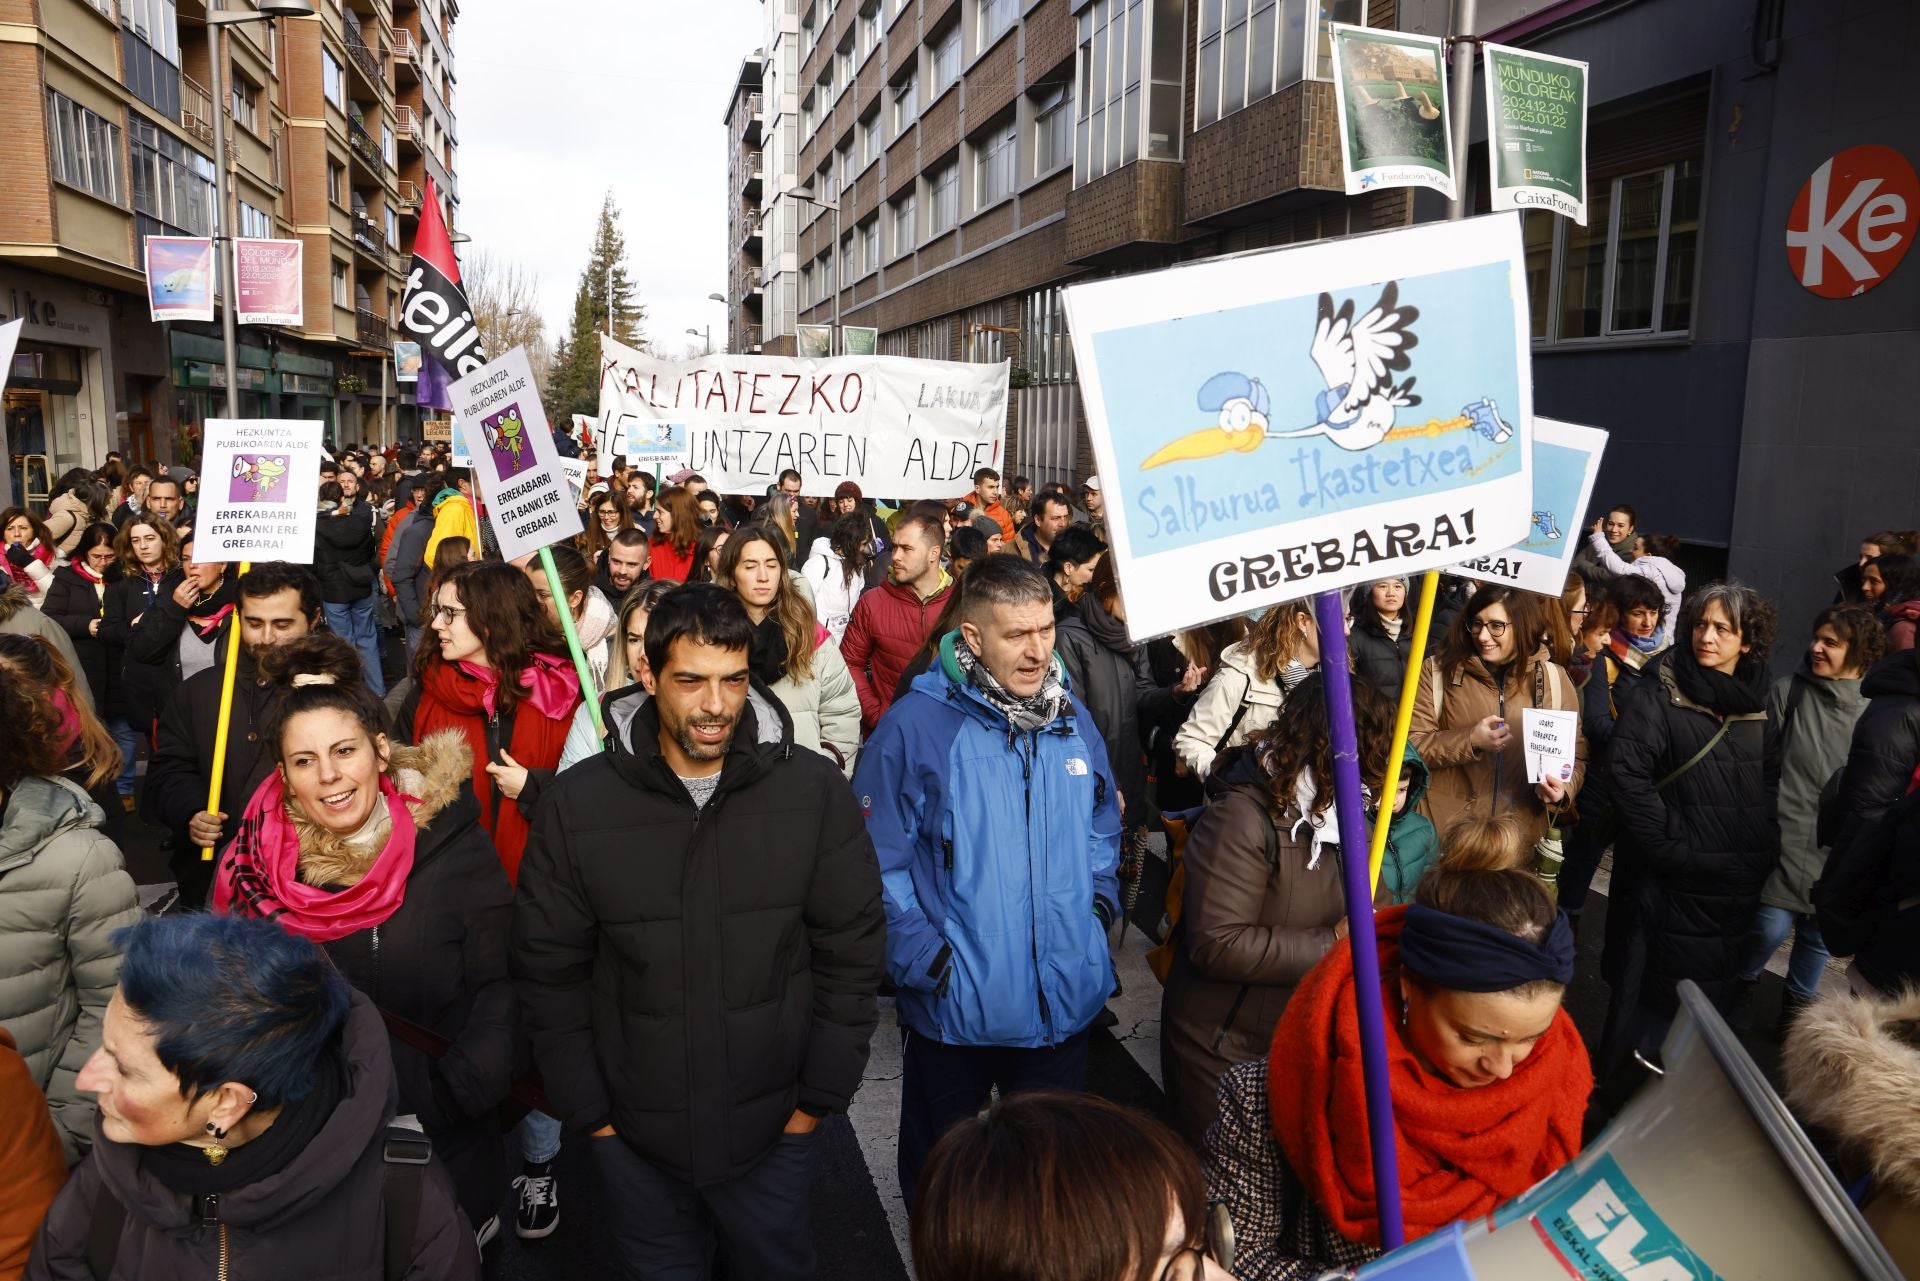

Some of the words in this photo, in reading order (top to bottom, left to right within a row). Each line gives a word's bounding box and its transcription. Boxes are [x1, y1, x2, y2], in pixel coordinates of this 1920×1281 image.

[1497, 63, 1571, 89] MUNDUKO
[1499, 77, 1577, 105] KOLOREAK
[1502, 94, 1569, 116] 2024.12.20-
[1503, 107, 1567, 129] 2025.01.22
[240, 247, 286, 258] COLORES
[240, 256, 259, 265] DEL
[245, 314, 292, 325] CaixaForum
[469, 368, 510, 397] HEZKUNTZA
[600, 350, 863, 415] KALITATEZKO
[463, 389, 510, 418] PUBLIKOAREN
[508, 377, 527, 396] ALDE
[216, 440, 283, 448] PUBLIKOAREN
[284, 441, 310, 449] ALDE
[236, 428, 293, 437] HEZKUNTZA
[597, 409, 867, 477] HEUNTZAREN
[903, 437, 999, 481] ALDE!
[563, 467, 582, 478] TZAK
[496, 471, 552, 506] ERREKABARRI
[1137, 474, 1281, 539] Salburua
[1289, 443, 1473, 509] Ikastetxea
[216, 509, 297, 520] ERREKABARRI
[501, 507, 518, 525] ETA
[517, 497, 544, 519] BANKI
[544, 489, 560, 507] ERE
[211, 525, 233, 535] ETA
[236, 524, 273, 534] BANKI
[277, 525, 299, 535] ERE
[515, 511, 559, 539] GREBARA!
[222, 539, 284, 549] GREBARA!
[1208, 507, 1478, 602] GREBARA!
[1552, 1216, 1591, 1266] EUSKAL
